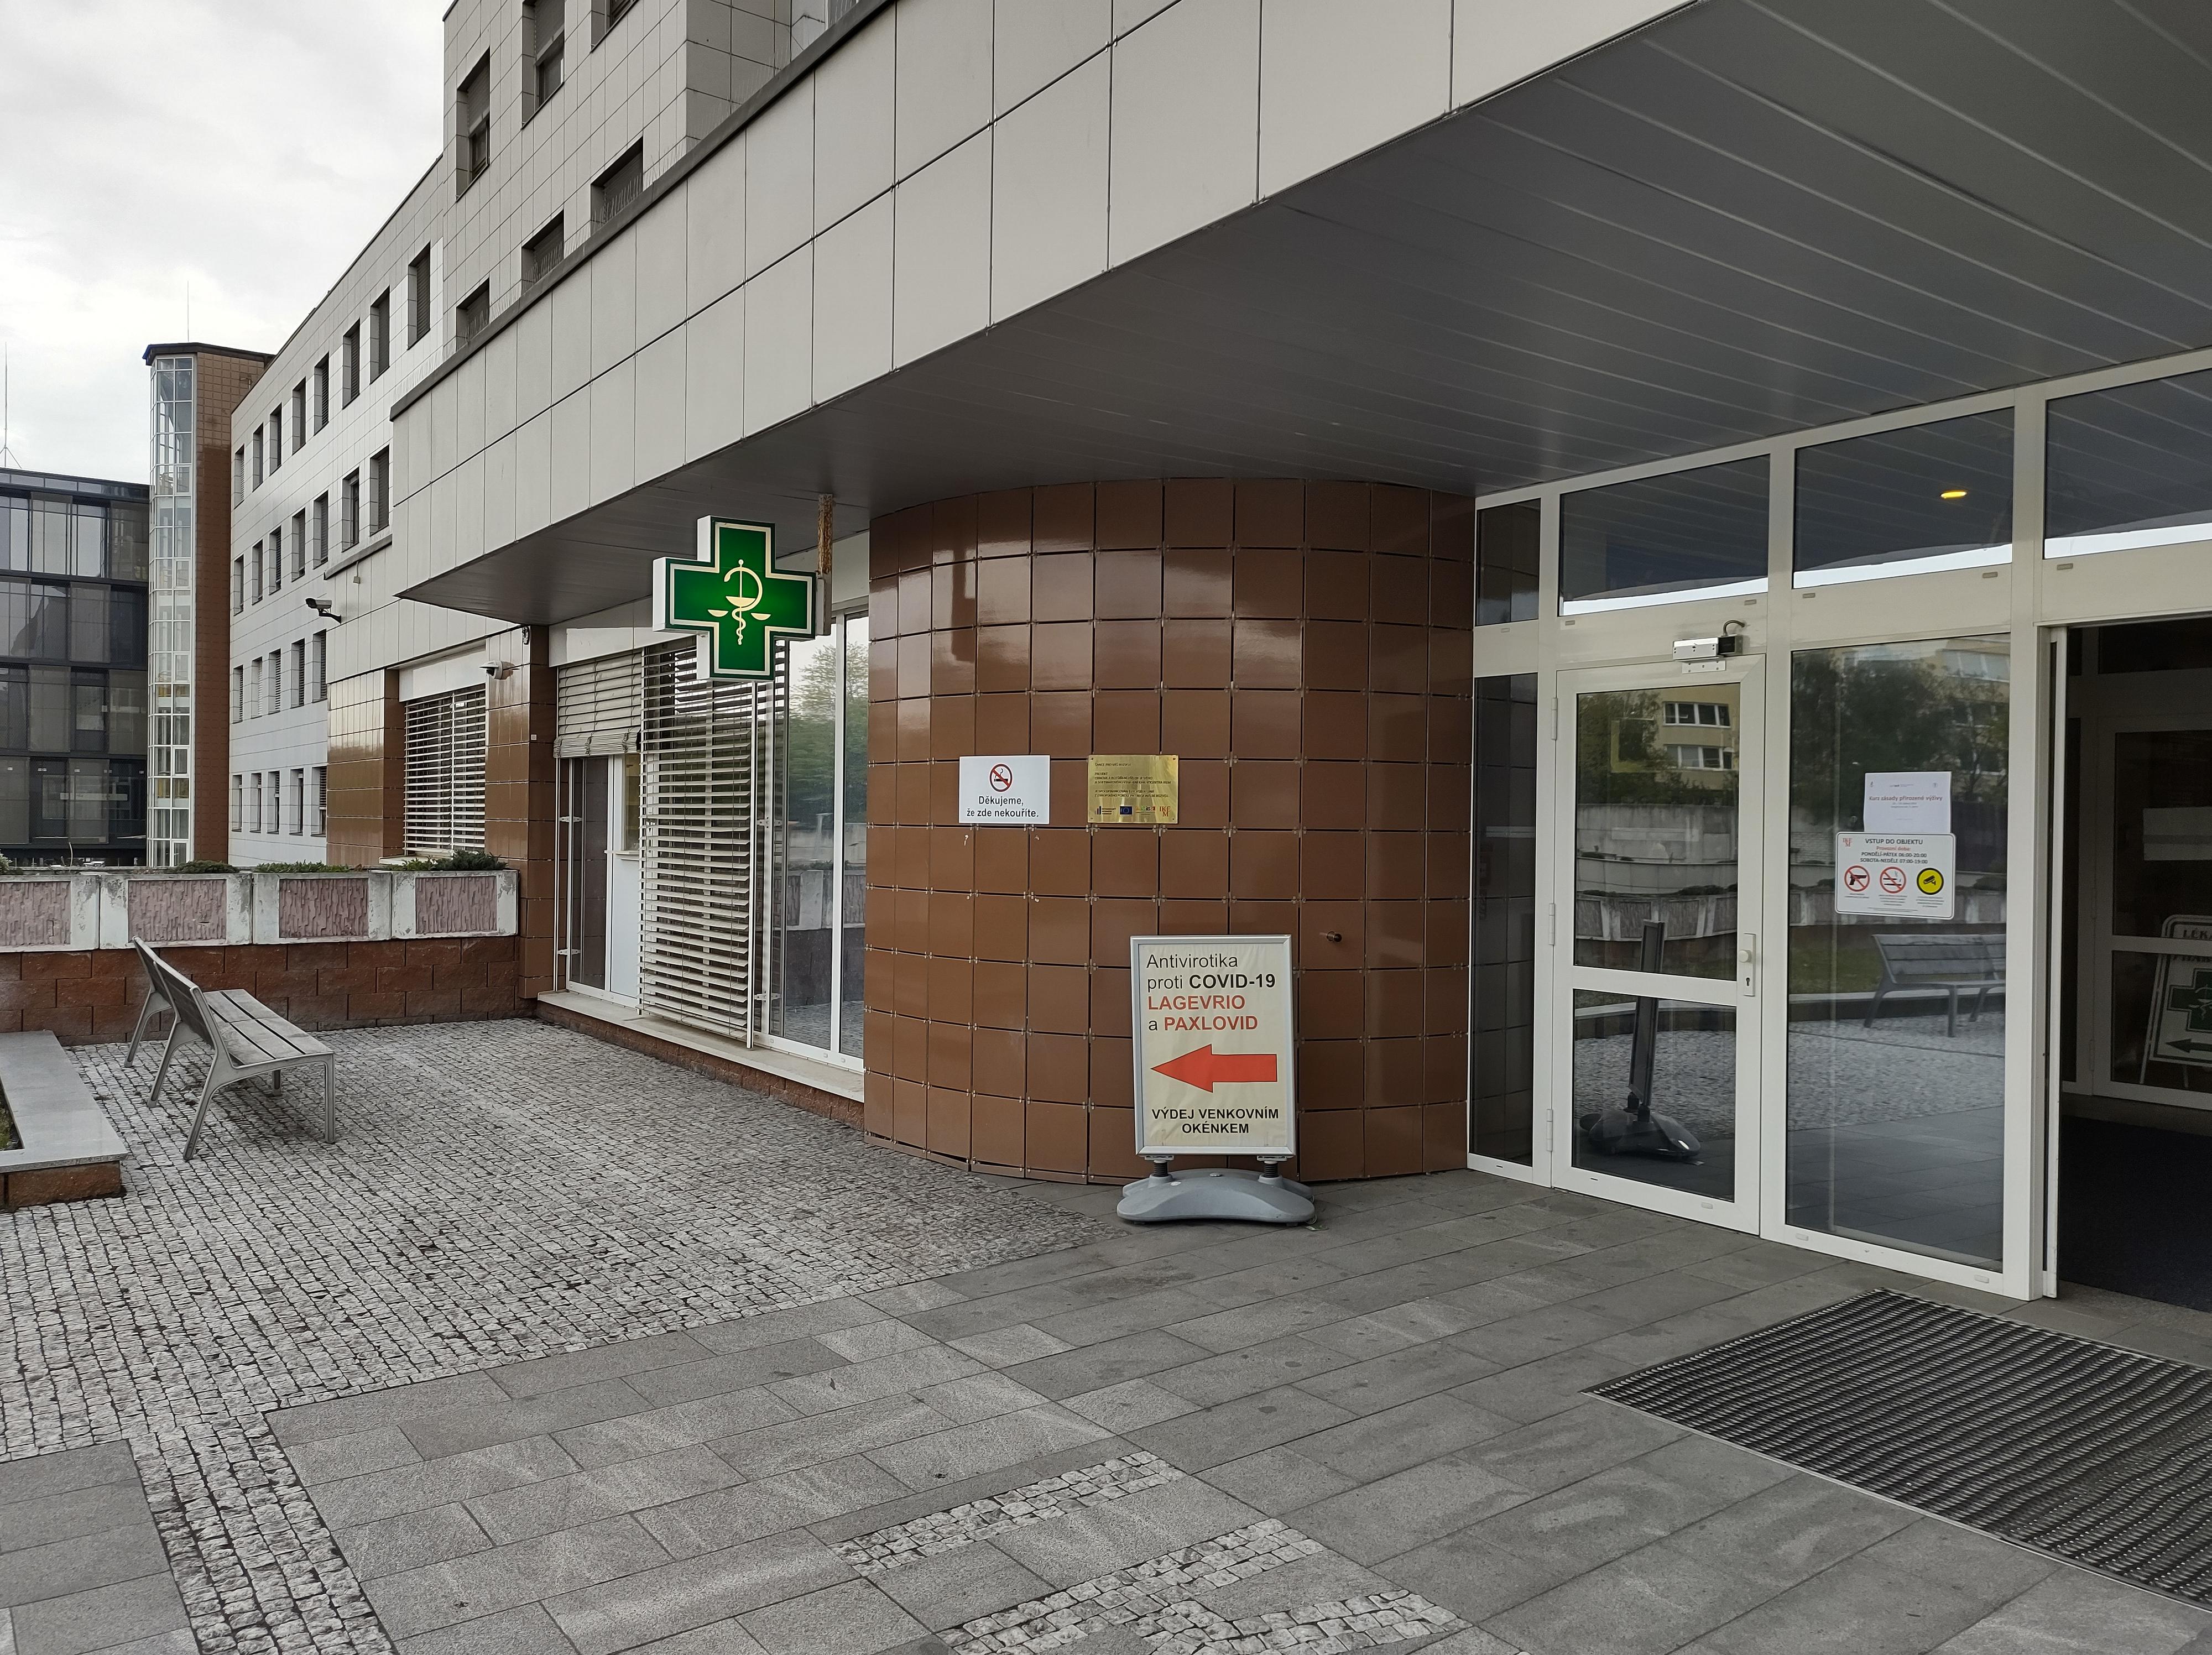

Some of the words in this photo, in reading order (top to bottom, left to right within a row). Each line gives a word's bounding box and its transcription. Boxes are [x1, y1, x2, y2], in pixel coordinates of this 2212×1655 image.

[979, 796, 1024, 806] Děkujeme,
[967, 807, 974, 816] že
[977, 808, 992, 817] zde
[995, 808, 1039, 817] nekouříte.
[1146, 954, 1238, 969] Antivirotika
[1147, 975, 1183, 992] proti
[1189, 973, 1276, 989] COVID-19
[1148, 995, 1245, 1010] LAGEVRIO
[1149, 1020, 1158, 1031] a
[1164, 1016, 1258, 1031] PAXLOVID
[1152, 1106, 1194, 1119] VÝDEJ
[1199, 1106, 1279, 1119] VENKOVNÍM
[1182, 1121, 1249, 1134] OKÉNKEM
